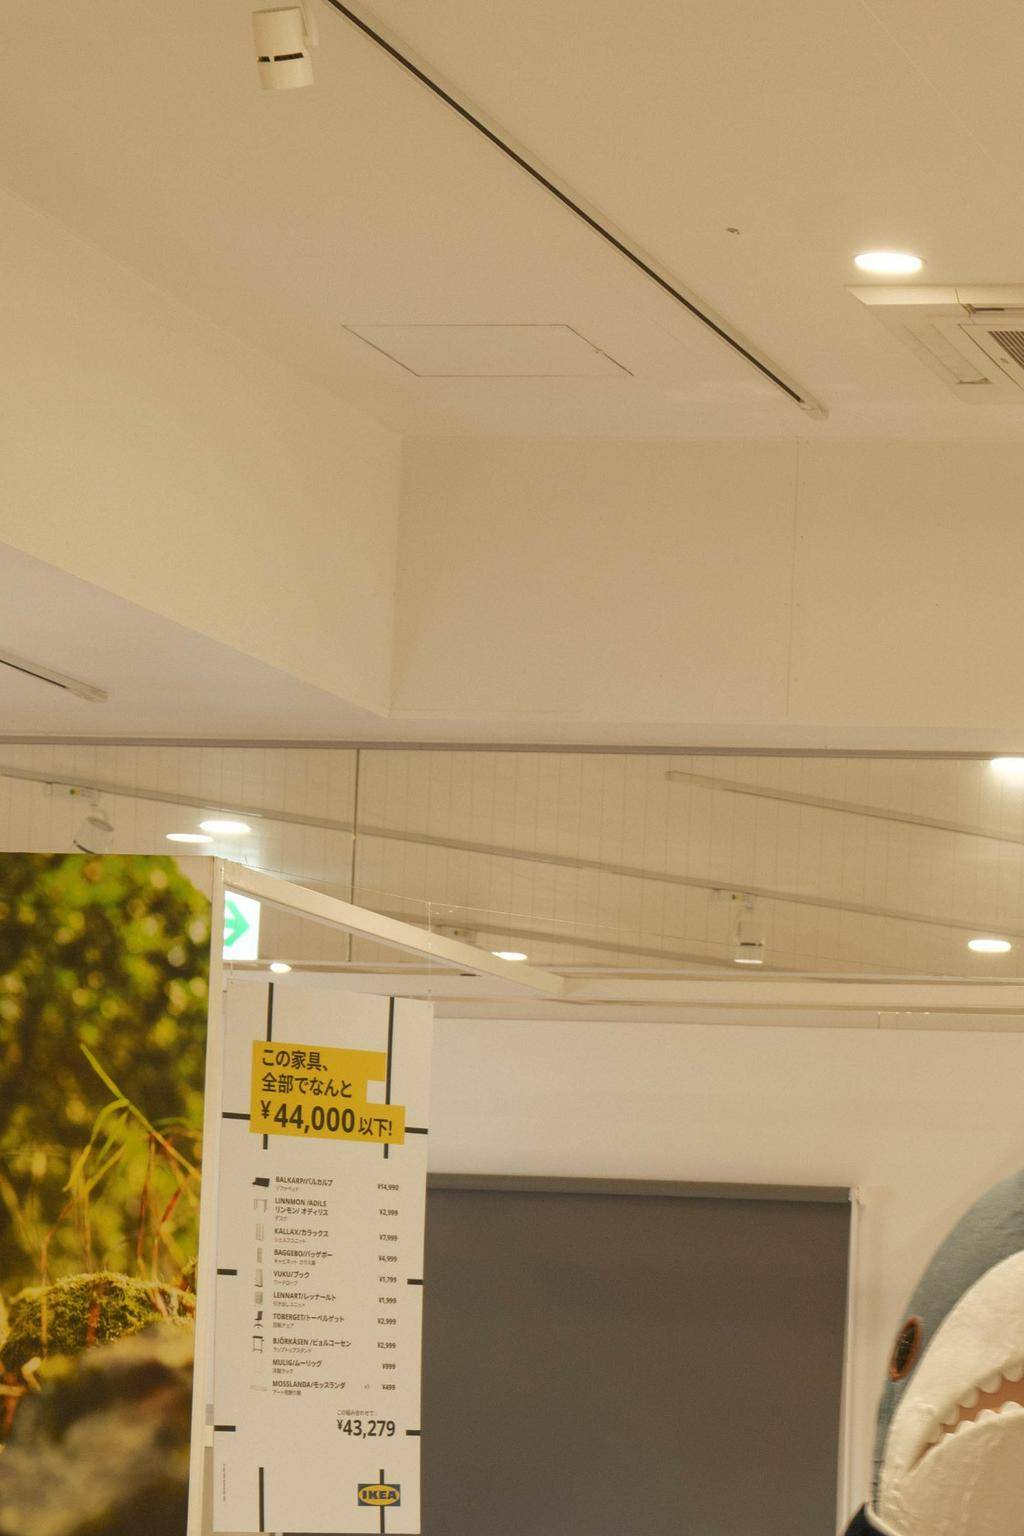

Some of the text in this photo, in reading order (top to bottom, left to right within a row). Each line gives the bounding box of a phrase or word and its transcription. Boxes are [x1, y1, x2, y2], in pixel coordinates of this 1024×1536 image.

[262, 1049, 328, 1072] この家具、
[261, 1072, 353, 1098] 全部でなんと
[336, 1419, 396, 1440] ¥43,279
[362, 1490, 397, 1500] IKEA
